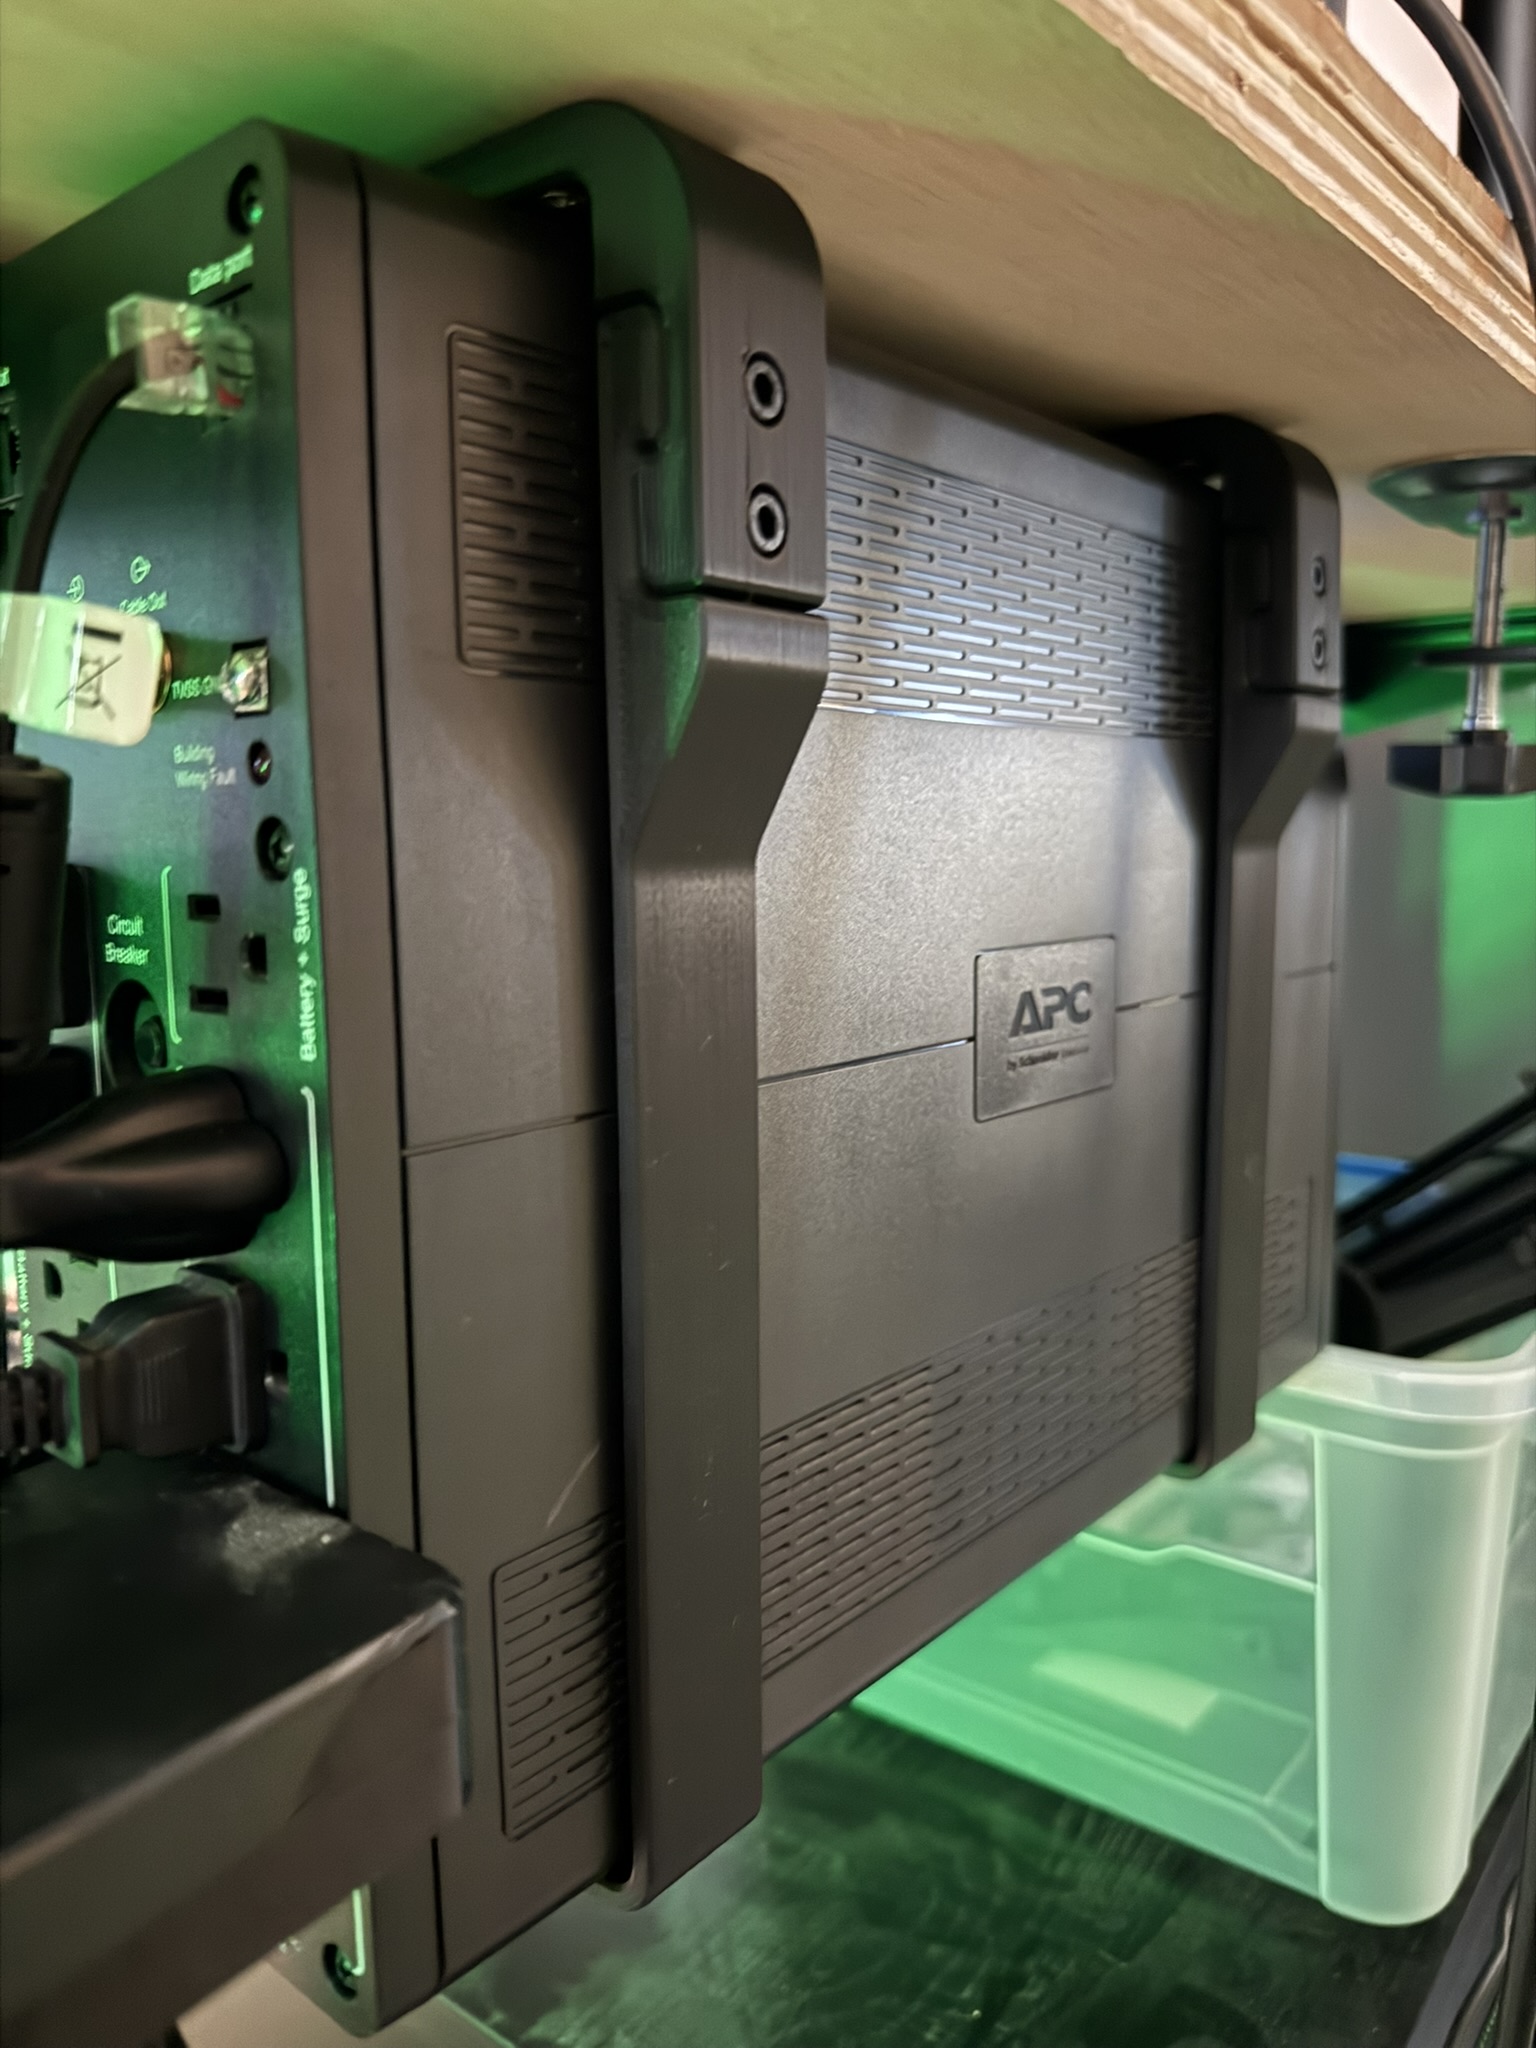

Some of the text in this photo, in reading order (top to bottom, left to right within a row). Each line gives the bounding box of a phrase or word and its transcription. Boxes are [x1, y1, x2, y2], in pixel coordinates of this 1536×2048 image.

[107, 913, 145, 937] Circuit
[293, 867, 313, 945] Surge
[105, 941, 151, 967] Breaker
[299, 972, 318, 1063] Battery
[1008, 981, 1093, 1039] APC
